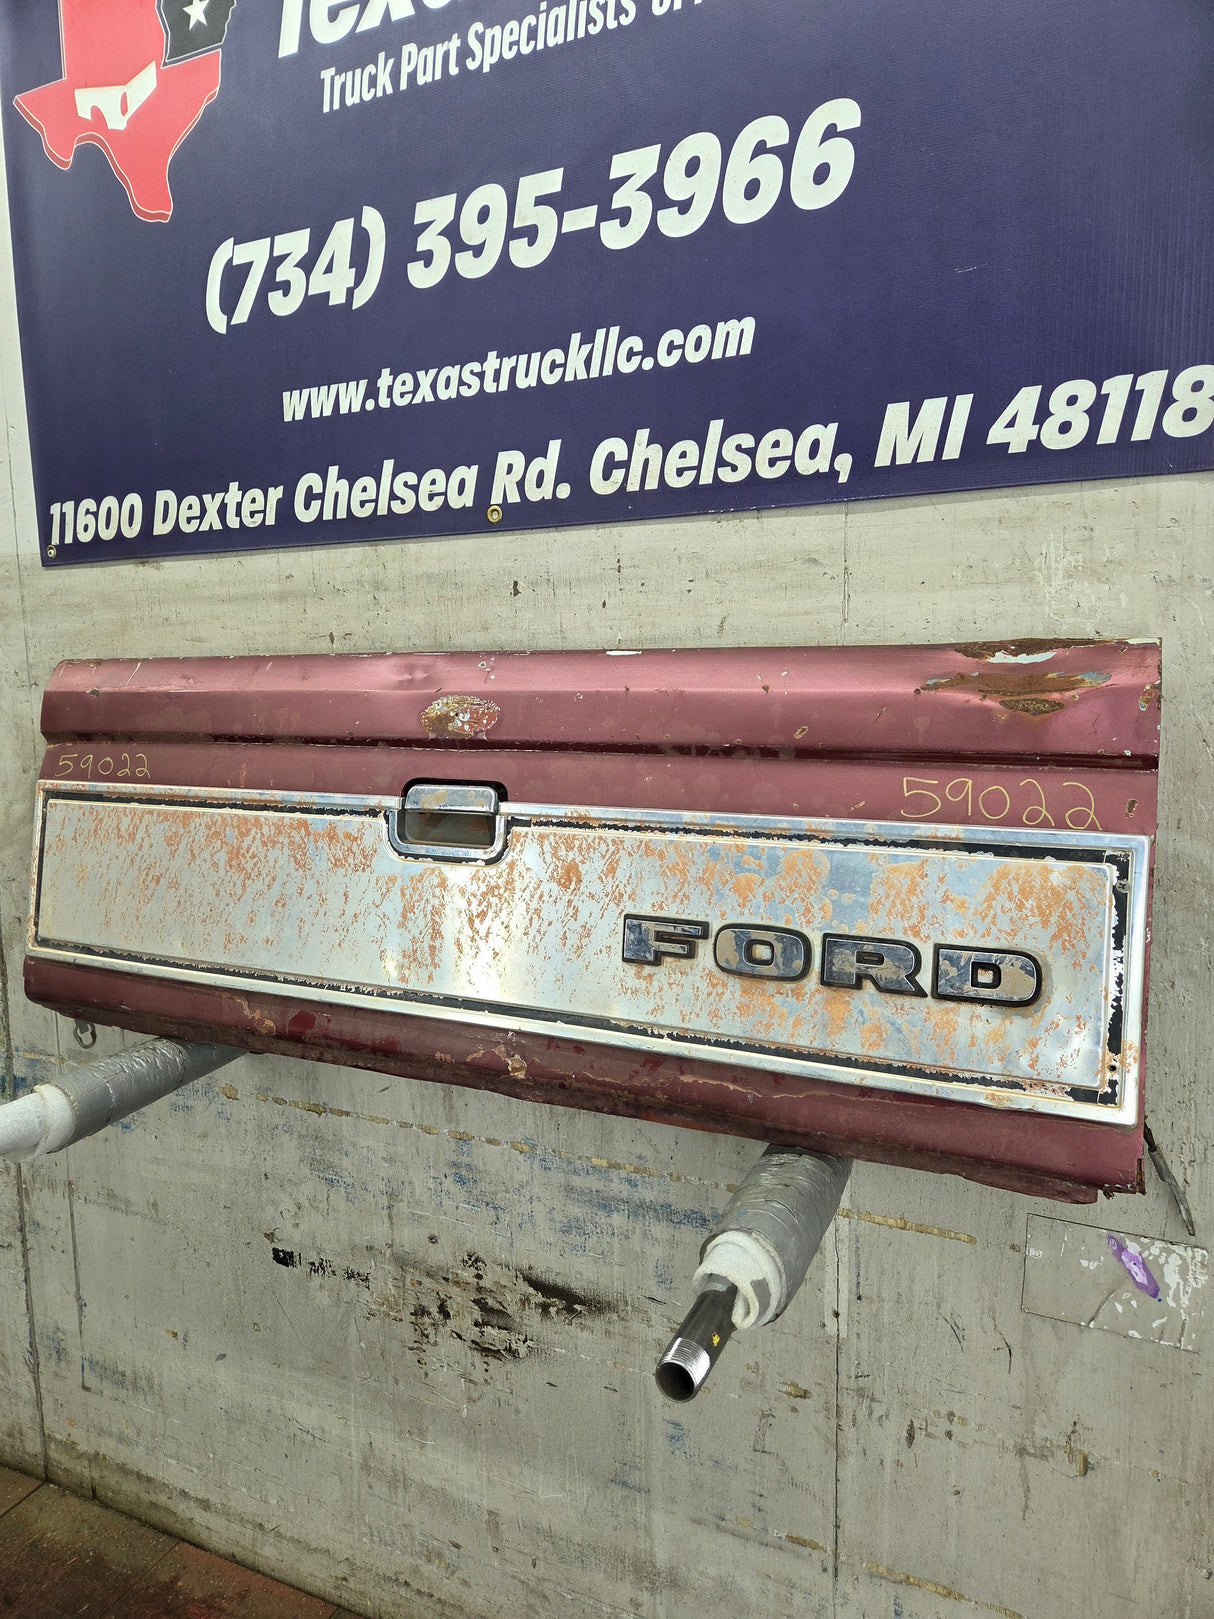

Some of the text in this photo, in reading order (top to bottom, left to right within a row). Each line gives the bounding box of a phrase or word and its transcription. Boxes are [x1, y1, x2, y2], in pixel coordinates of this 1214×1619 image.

[320, 0, 637, 114] Truck Part Specialists
[205, 97, 862, 335] (734) 395-3966
[282, 316, 756, 423] www.texastruckllc.com
[49, 364, 1214, 546] 11600 Dexter Chelsea Rd. Chelsea, MI 48118
[54, 752, 151, 779] 59022
[900, 777, 1103, 831] 59022
[621, 912, 1043, 1007] FORD
